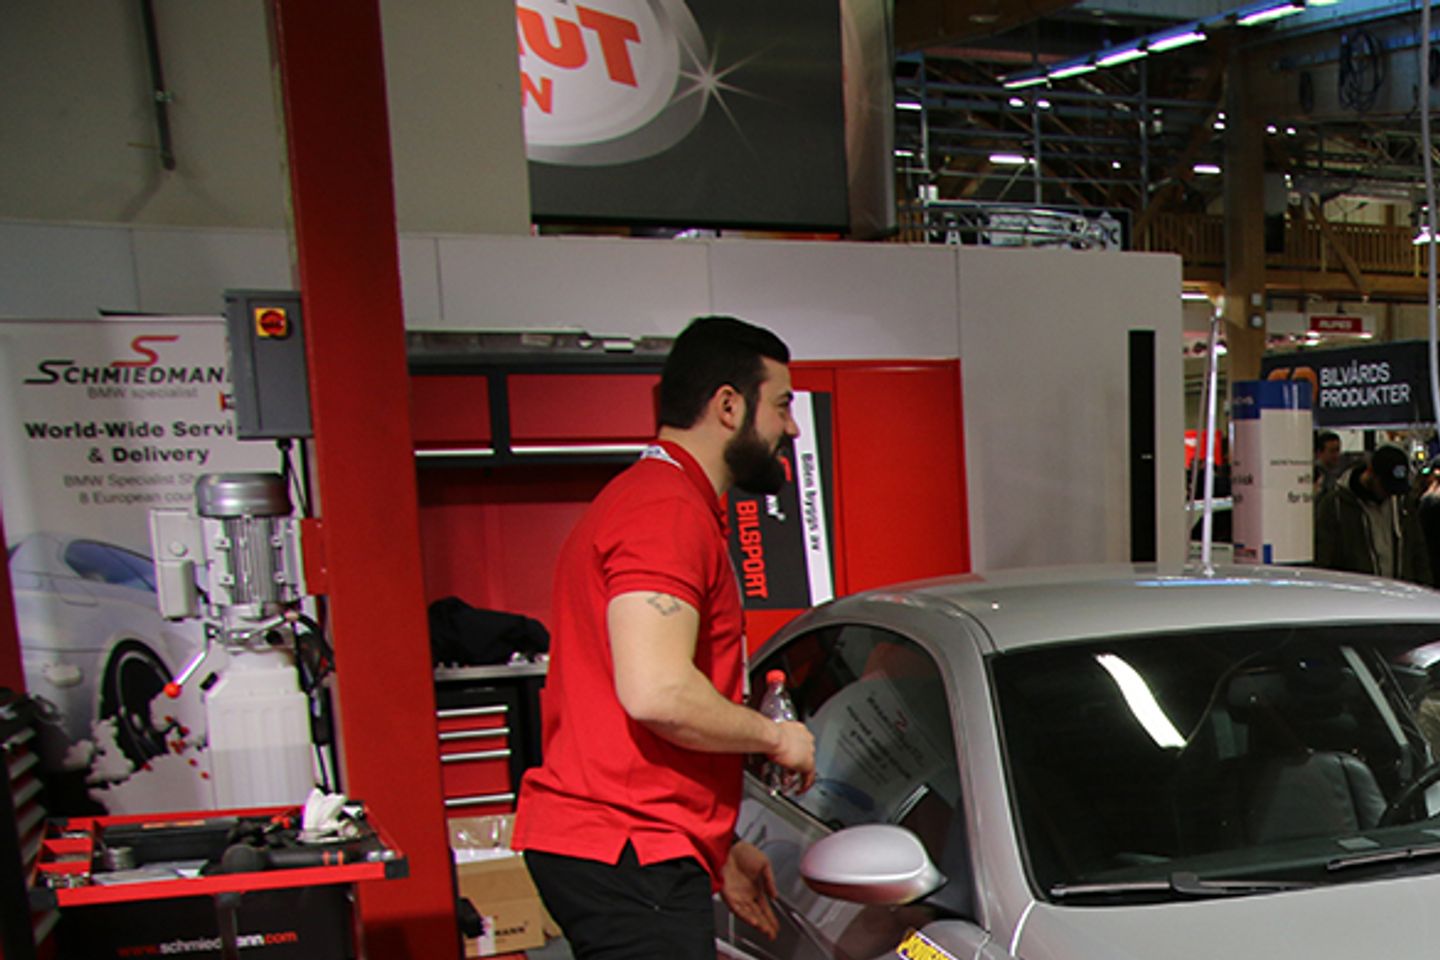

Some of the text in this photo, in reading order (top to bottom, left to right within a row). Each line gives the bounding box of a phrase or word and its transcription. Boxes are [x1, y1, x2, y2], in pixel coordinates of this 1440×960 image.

[22, 360, 234, 386] SCHMIEDMAN
[1320, 360, 1391, 388] BILVÅRDS
[86, 384, 126, 399] BMW
[1320, 384, 1411, 408] PRODUKTER
[24, 418, 236, 440] World-Wide Servi
[87, 445, 210, 466] & Delivery
[735, 500, 769, 599] BILSPORT
[117, 930, 298, 958] www.schmiedann.com
